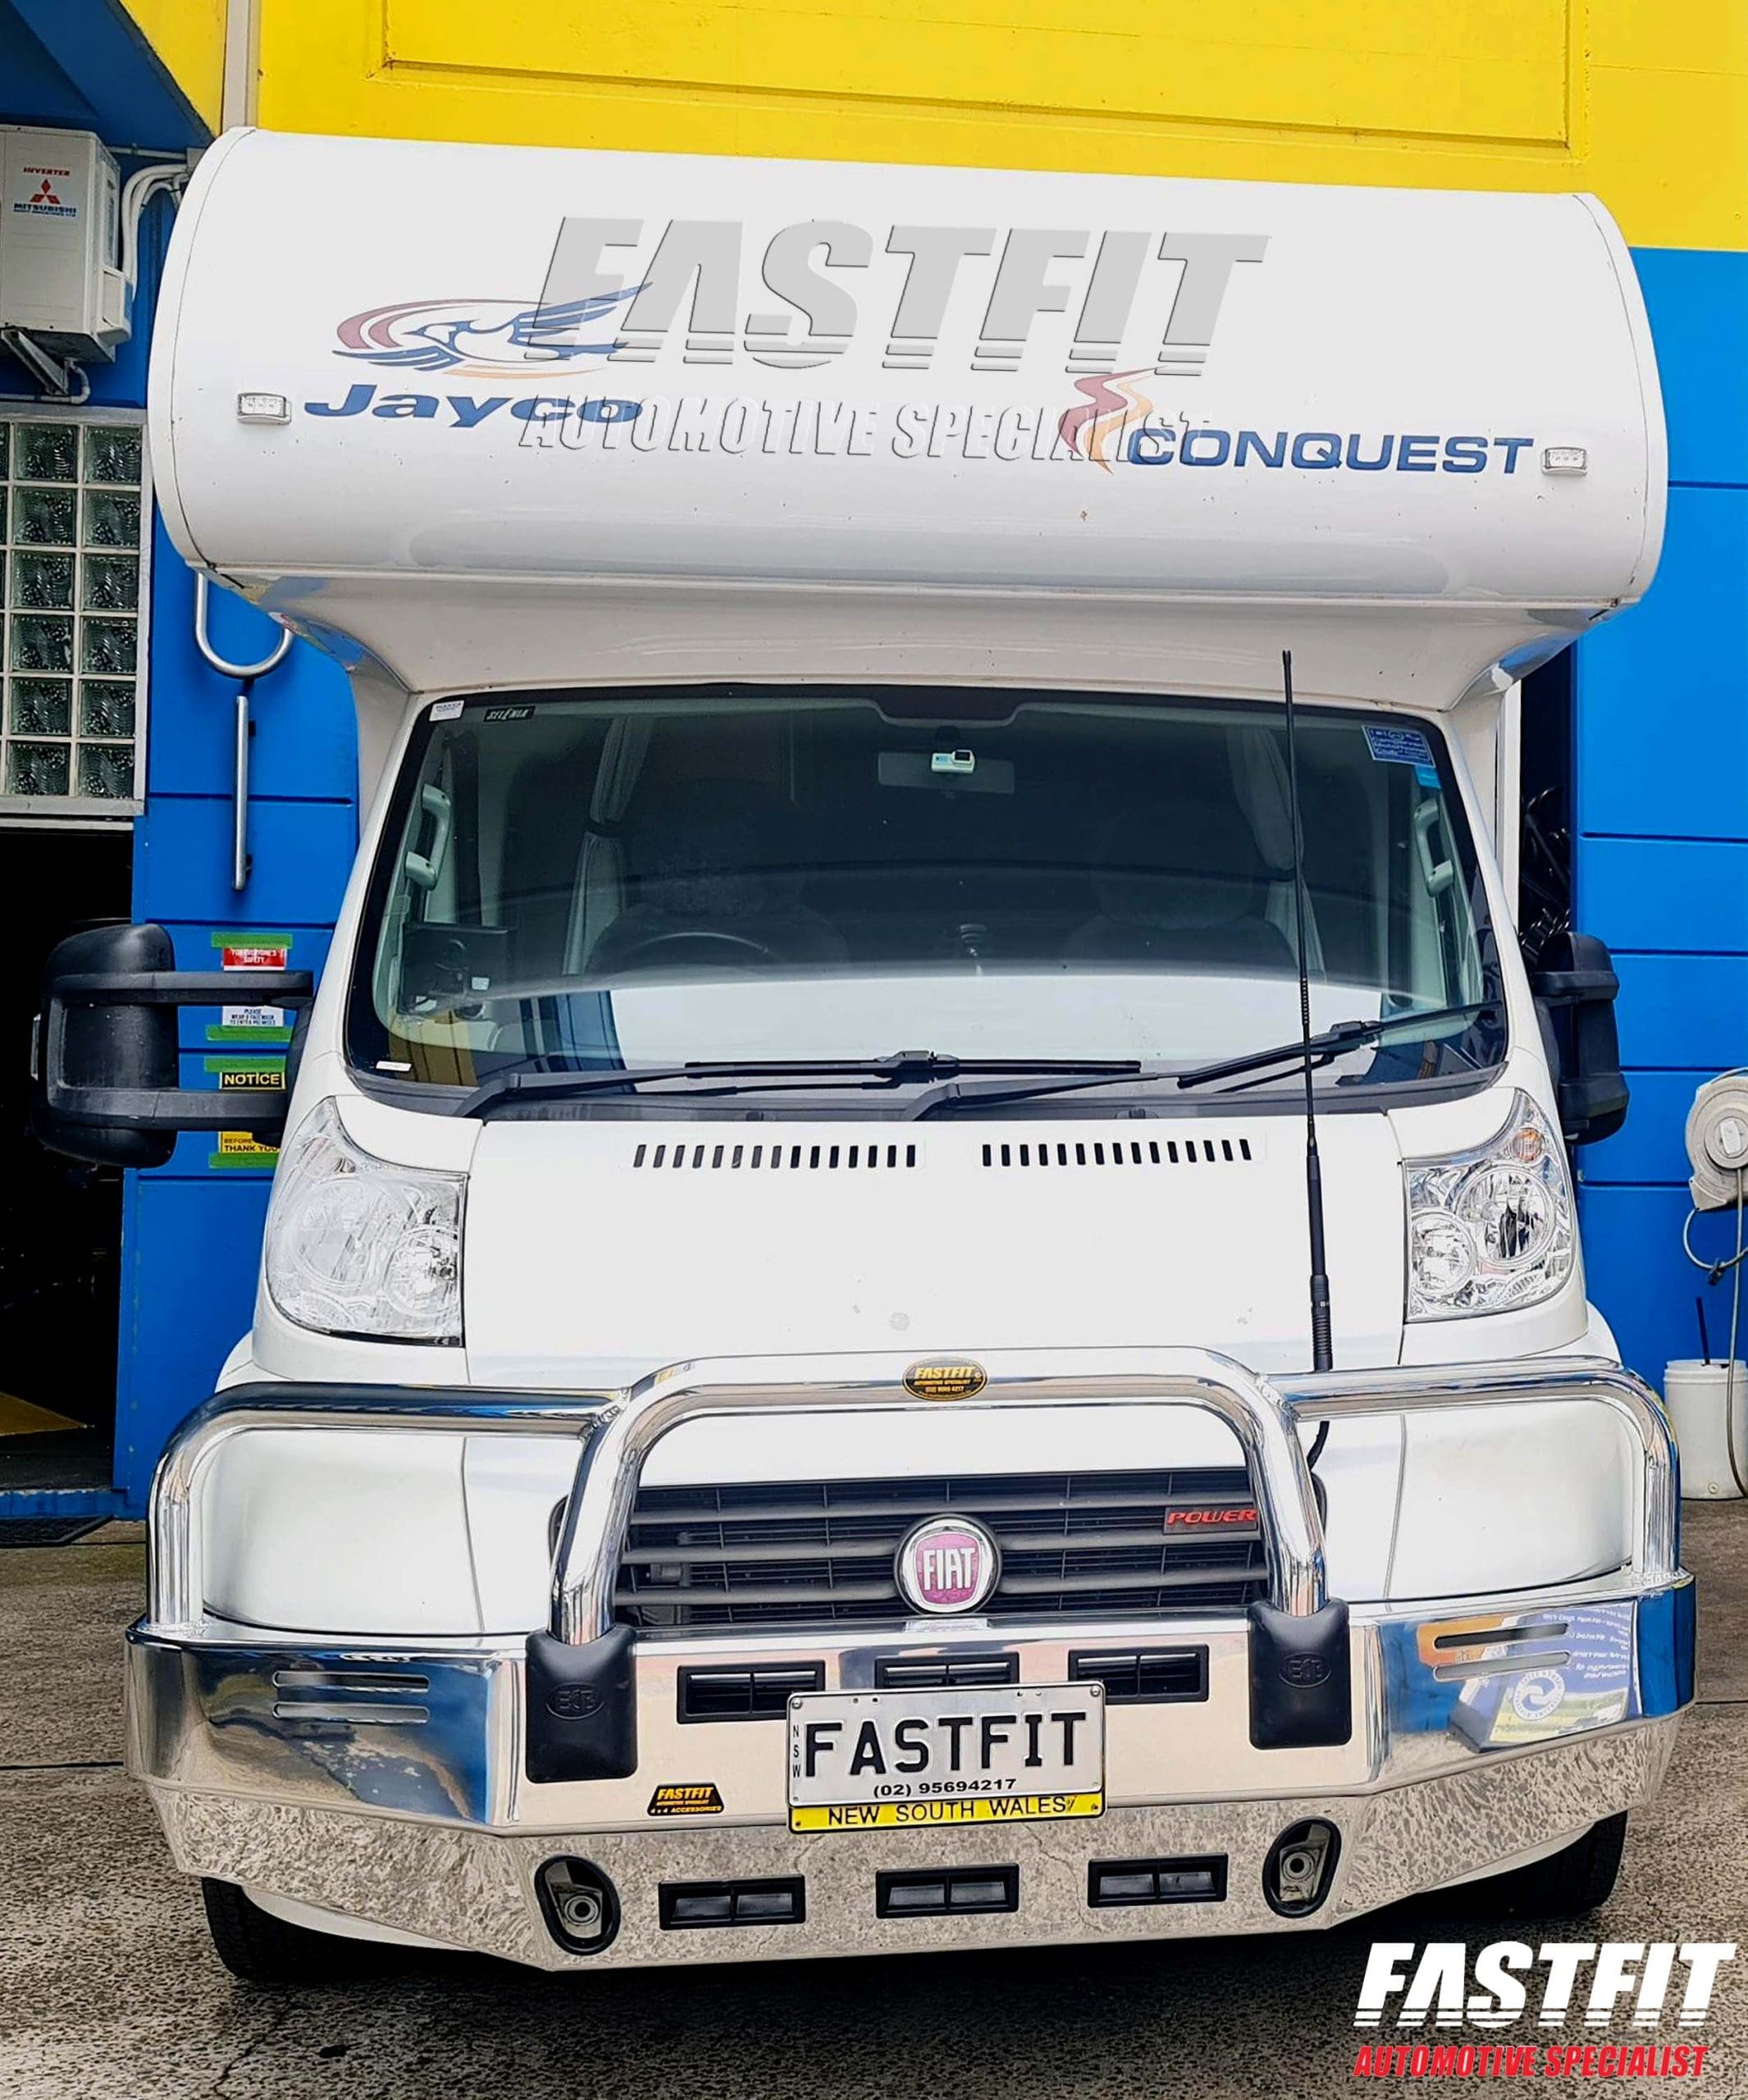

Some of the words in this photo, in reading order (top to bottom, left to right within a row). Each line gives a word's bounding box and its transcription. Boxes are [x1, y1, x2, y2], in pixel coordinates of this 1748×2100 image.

[23, 167, 71, 176] INVERTER
[14, 203, 77, 214] MITSUBISHI
[304, 385, 643, 428] Jayco
[1126, 428, 1536, 475] CONQUEST
[224, 1073, 281, 1085] NOTICE
[915, 1367, 975, 1379] FASTFIT
[1167, 1509, 1257, 1525] POWER
[923, 1547, 975, 1591] FIAT
[806, 1712, 1086, 1777] FASTFIT
[657, 1787, 714, 1800] FASTFIT
[873, 1783, 912, 1798] (02)
[918, 1778, 1017, 1795] 95694217
[828, 1806, 880, 1825] NEW
[895, 1800, 975, 1822] SOUTH
[988, 1795, 1067, 1815] WALES
